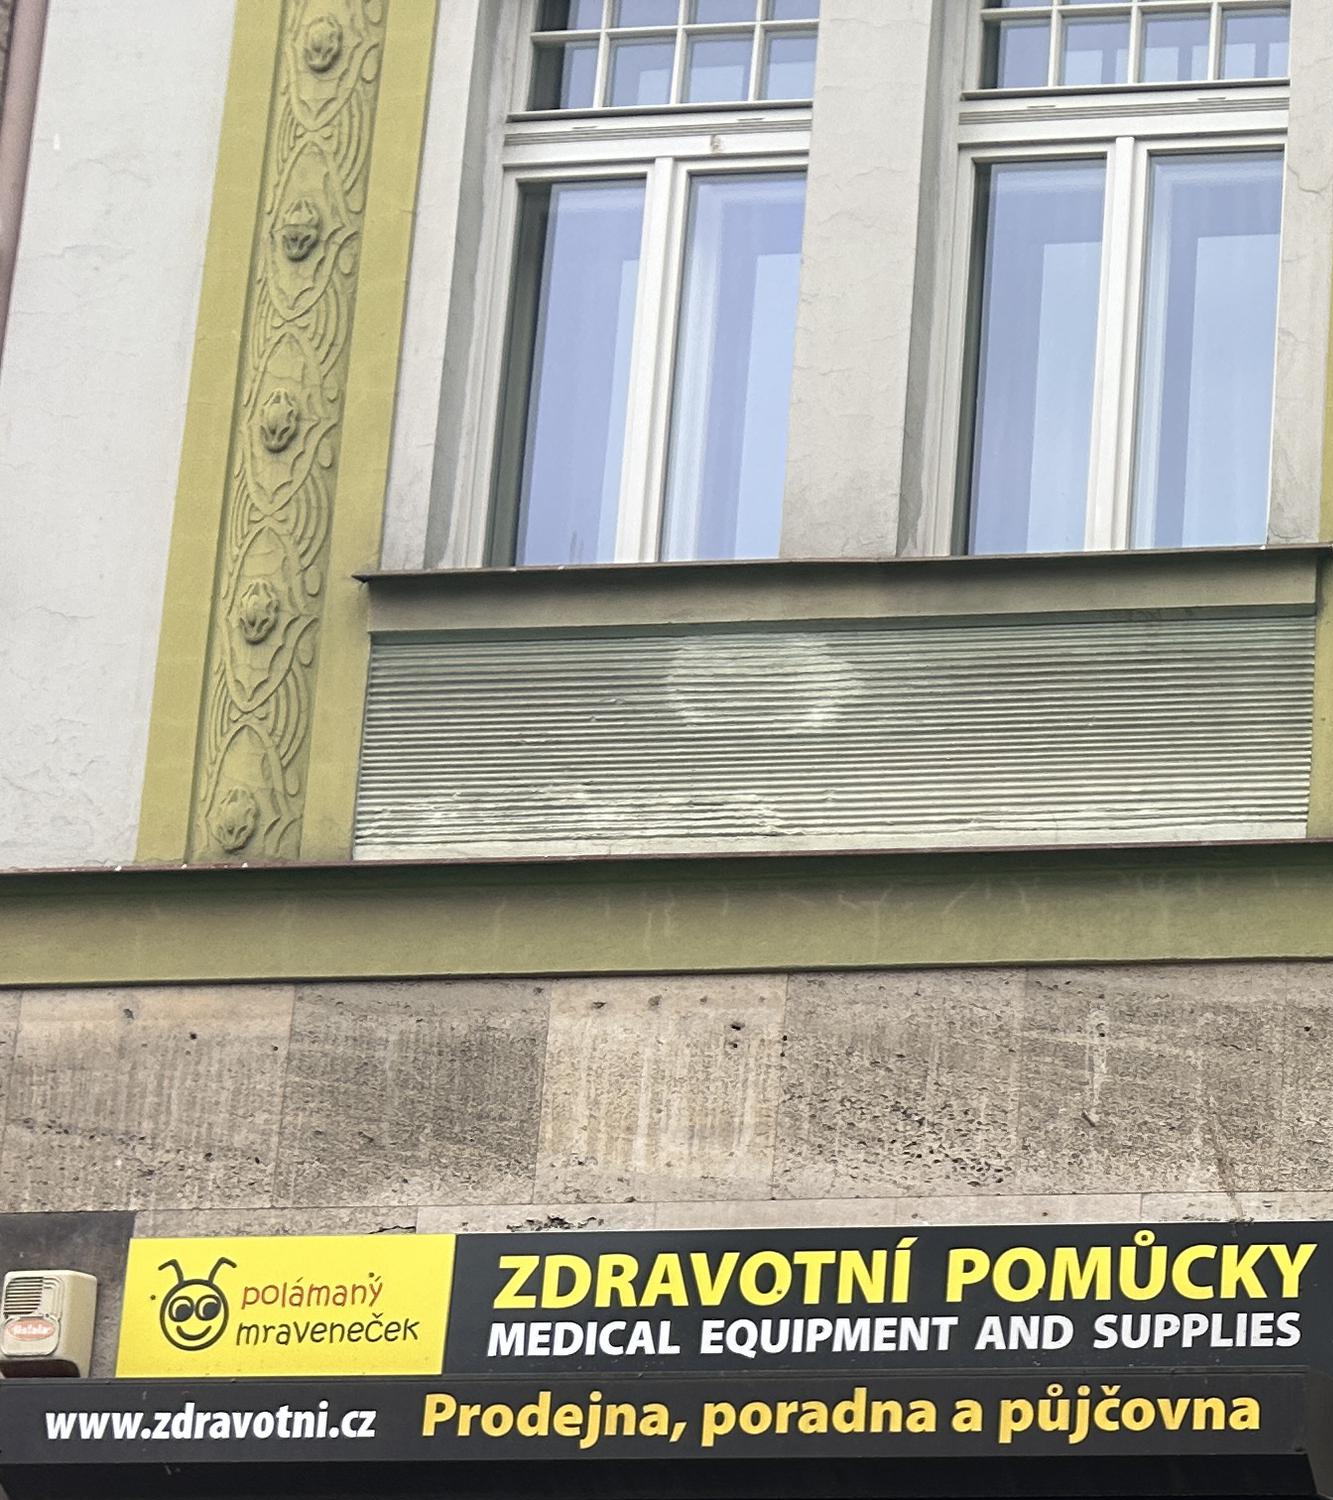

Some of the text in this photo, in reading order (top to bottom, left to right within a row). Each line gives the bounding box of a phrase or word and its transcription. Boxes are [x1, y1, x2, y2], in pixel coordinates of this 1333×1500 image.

[492, 1229, 1318, 1309] ZDRAVOTNÍ POMŮCKY
[241, 1276, 383, 1310] polámaný
[236, 1312, 420, 1346] mraveneček
[487, 1311, 1301, 1359] MEDICAL EQUIPMENT AND SUPPLIES
[45, 1400, 377, 1440] www.zdravotni.cz
[422, 1384, 1261, 1450] Prodejna, poradna a půjčovna
